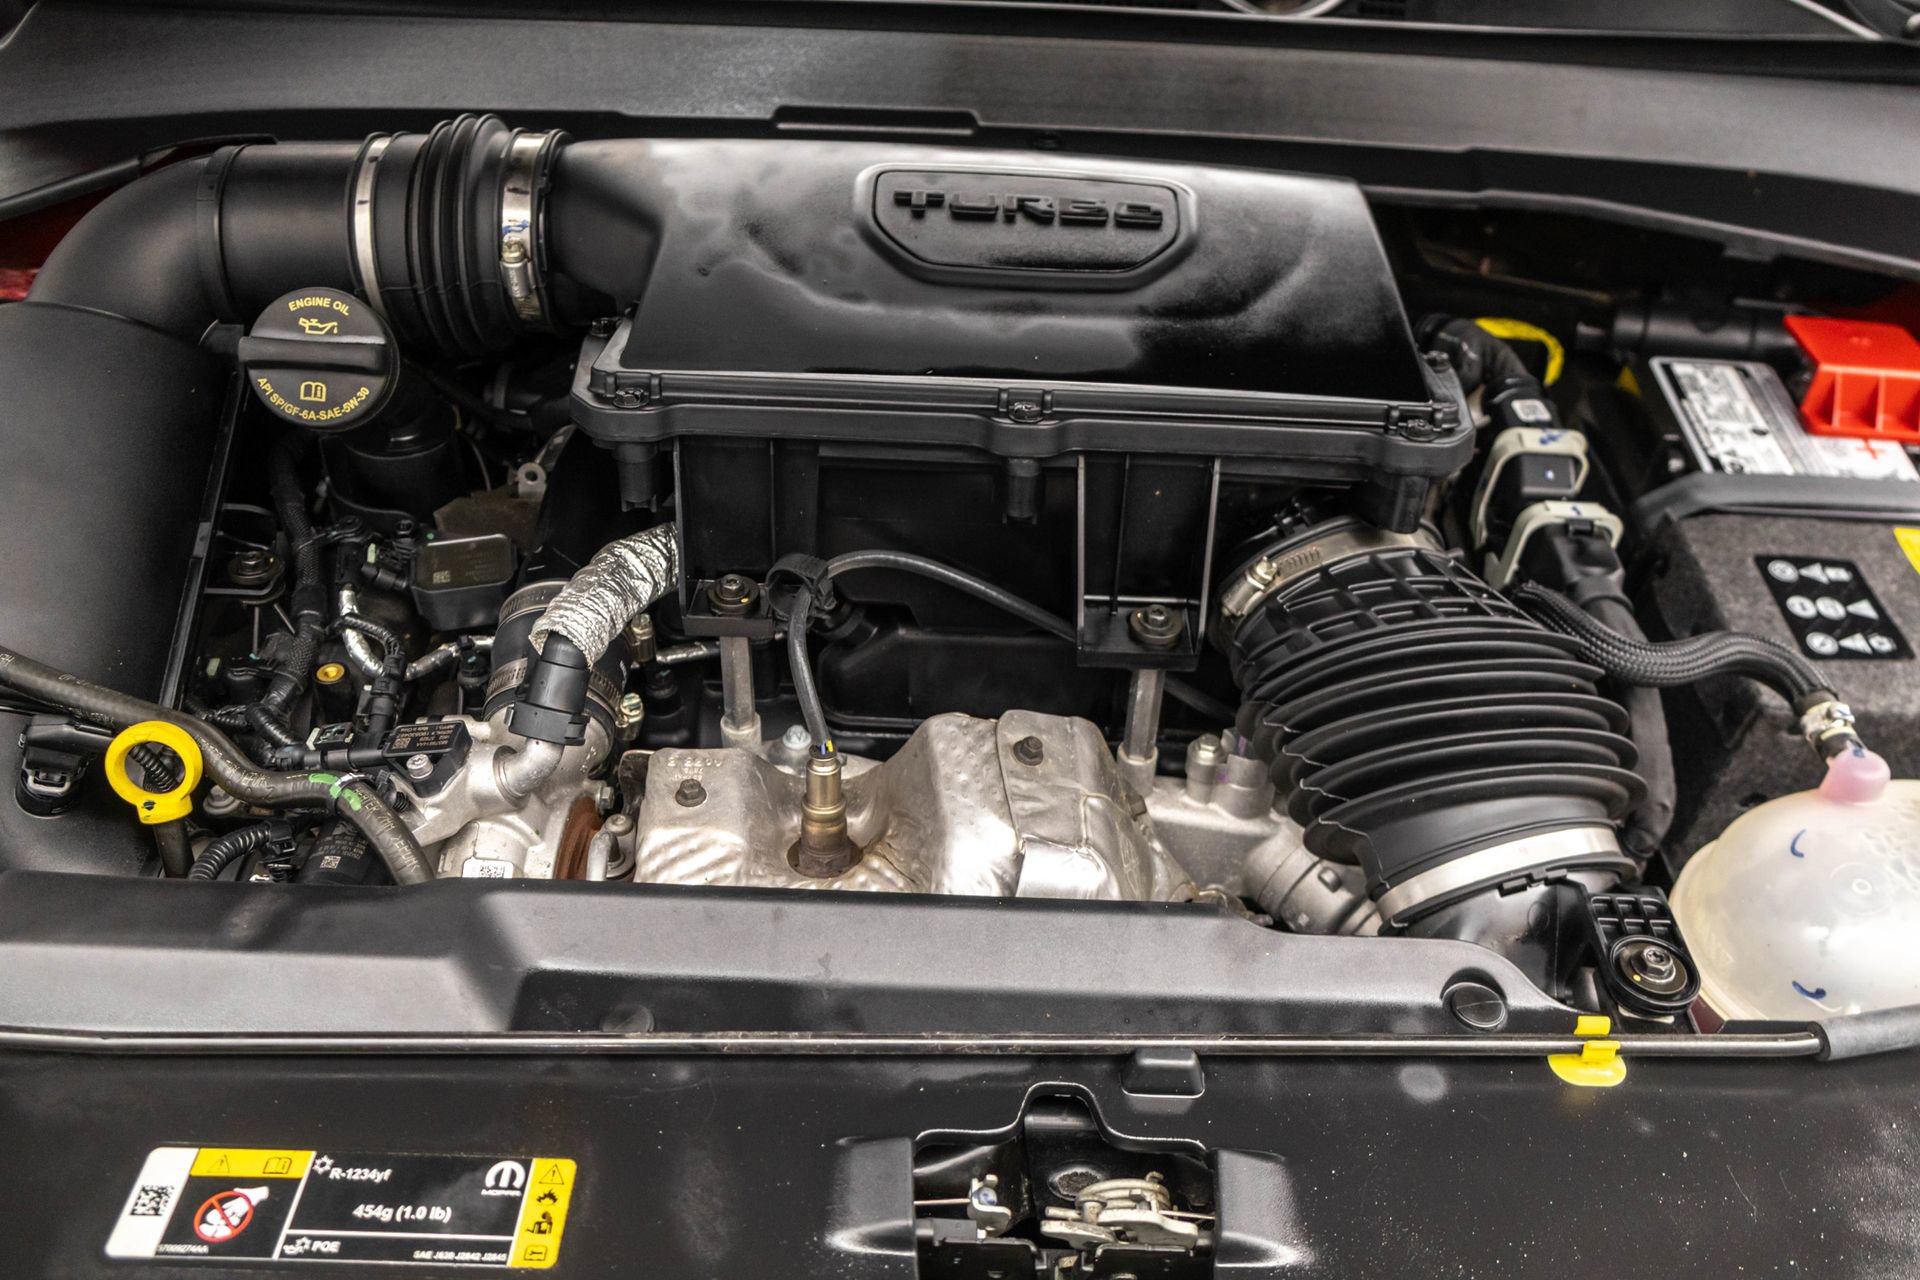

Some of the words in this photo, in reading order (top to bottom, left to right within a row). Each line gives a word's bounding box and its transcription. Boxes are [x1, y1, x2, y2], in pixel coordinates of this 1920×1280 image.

[893, 190, 1163, 229] TURBO
[288, 296, 332, 312] ENGINE
[332, 300, 351, 316] OIL
[257, 376, 271, 396] API
[329, 1167, 393, 1184] R-1234yf
[352, 1203, 394, 1222] 454g
[395, 1205, 427, 1223] (1.0
[428, 1206, 453, 1223] lb)
[311, 1240, 342, 1253] POE
[413, 1250, 433, 1259] SAE
